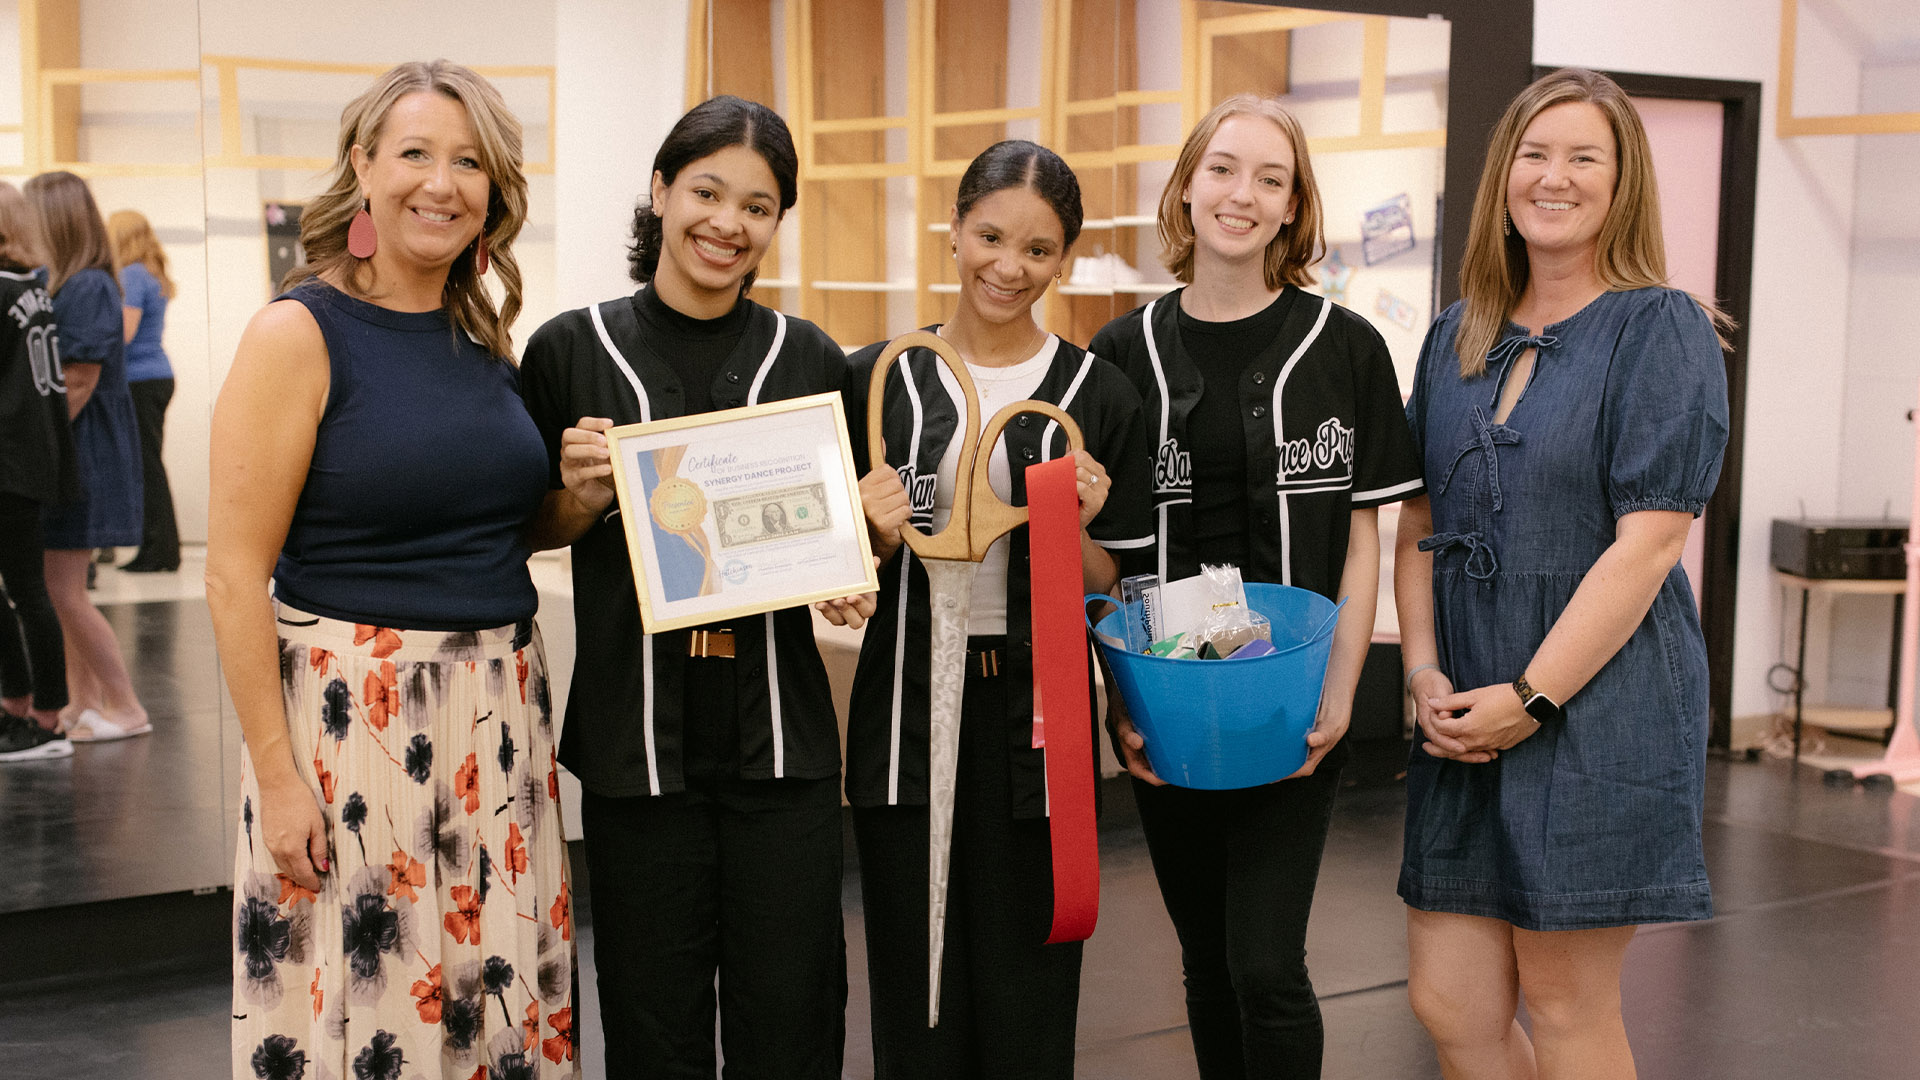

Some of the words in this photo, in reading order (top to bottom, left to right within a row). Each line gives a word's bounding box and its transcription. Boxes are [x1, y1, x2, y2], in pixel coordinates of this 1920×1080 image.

[688, 453, 737, 473] Certificate
[728, 460, 759, 473] BUSINESS
[760, 454, 806, 468] RECOGNITION
[704, 474, 743, 487] SYNERGY
[745, 469, 773, 481] DANCE
[775, 462, 812, 475] PROJECT
